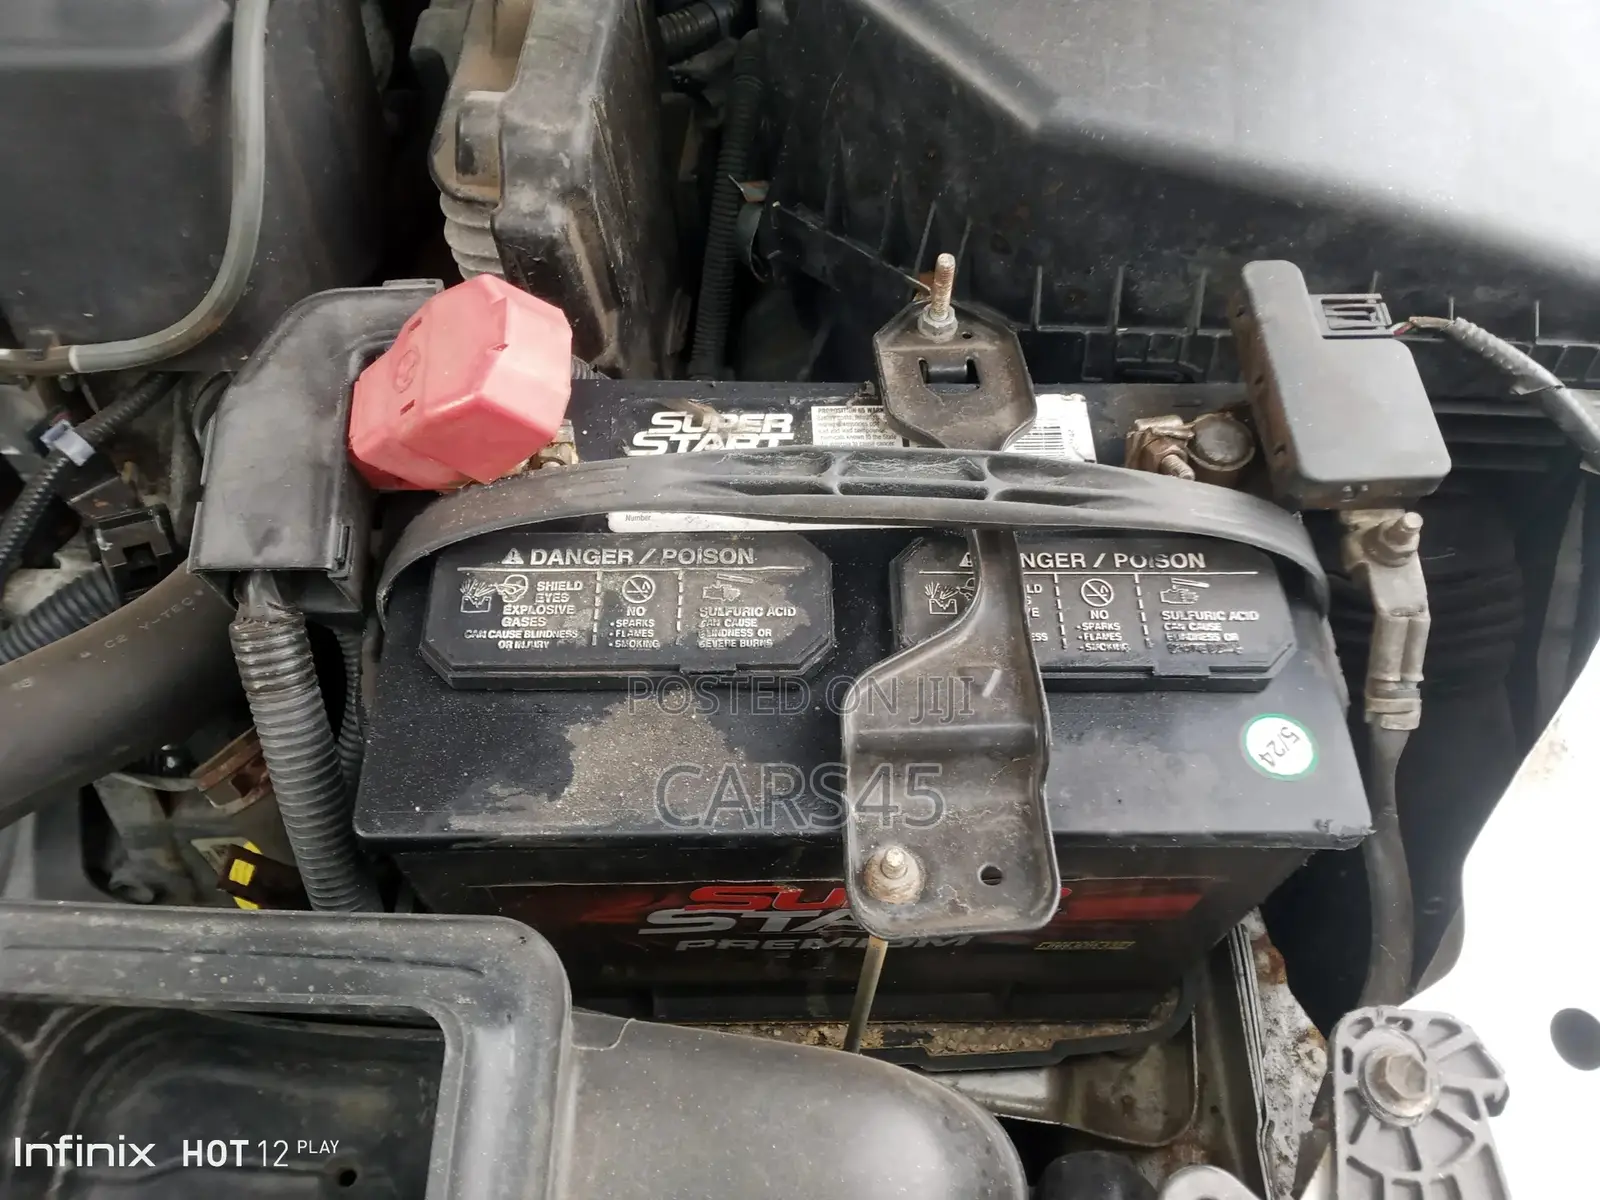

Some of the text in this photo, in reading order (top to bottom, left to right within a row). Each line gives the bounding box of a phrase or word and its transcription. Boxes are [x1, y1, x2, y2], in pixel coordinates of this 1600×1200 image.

[648, 411, 794, 434] SUPER
[626, 431, 795, 456] START
[530, 549, 634, 566] DANGER
[662, 548, 754, 565] POISON
[1020, 552, 1086, 569] NGER
[1114, 552, 1206, 569] POISON
[536, 581, 583, 591] SHIELD
[535, 592, 569, 603] EYES
[503, 605, 575, 615] EXPLOSIVE
[626, 607, 646, 617] NO
[699, 607, 796, 617] SULFURIC ACID
[1090, 610, 1109, 620] NO
[1161, 610, 1260, 620] SULFURIC ACID
[501, 616, 548, 627] GASES
[615, 619, 655, 628] SPARKS
[724, 619, 757, 628] CAUSE
[1188, 622, 1222, 631] CAUSE
[1082, 623, 1121, 631] SPARKS
[487, 630, 523, 639] CAUSE
[524, 630, 578, 639] BLINDNESS
[615, 629, 654, 638] FLAMES
[757, 629, 772, 637] OR
[1084, 633, 1122, 641] FLAMES
[497, 640, 513, 649] OR
[1258, 726, 1301, 767] 5/24
[638, 908, 867, 935] STA
